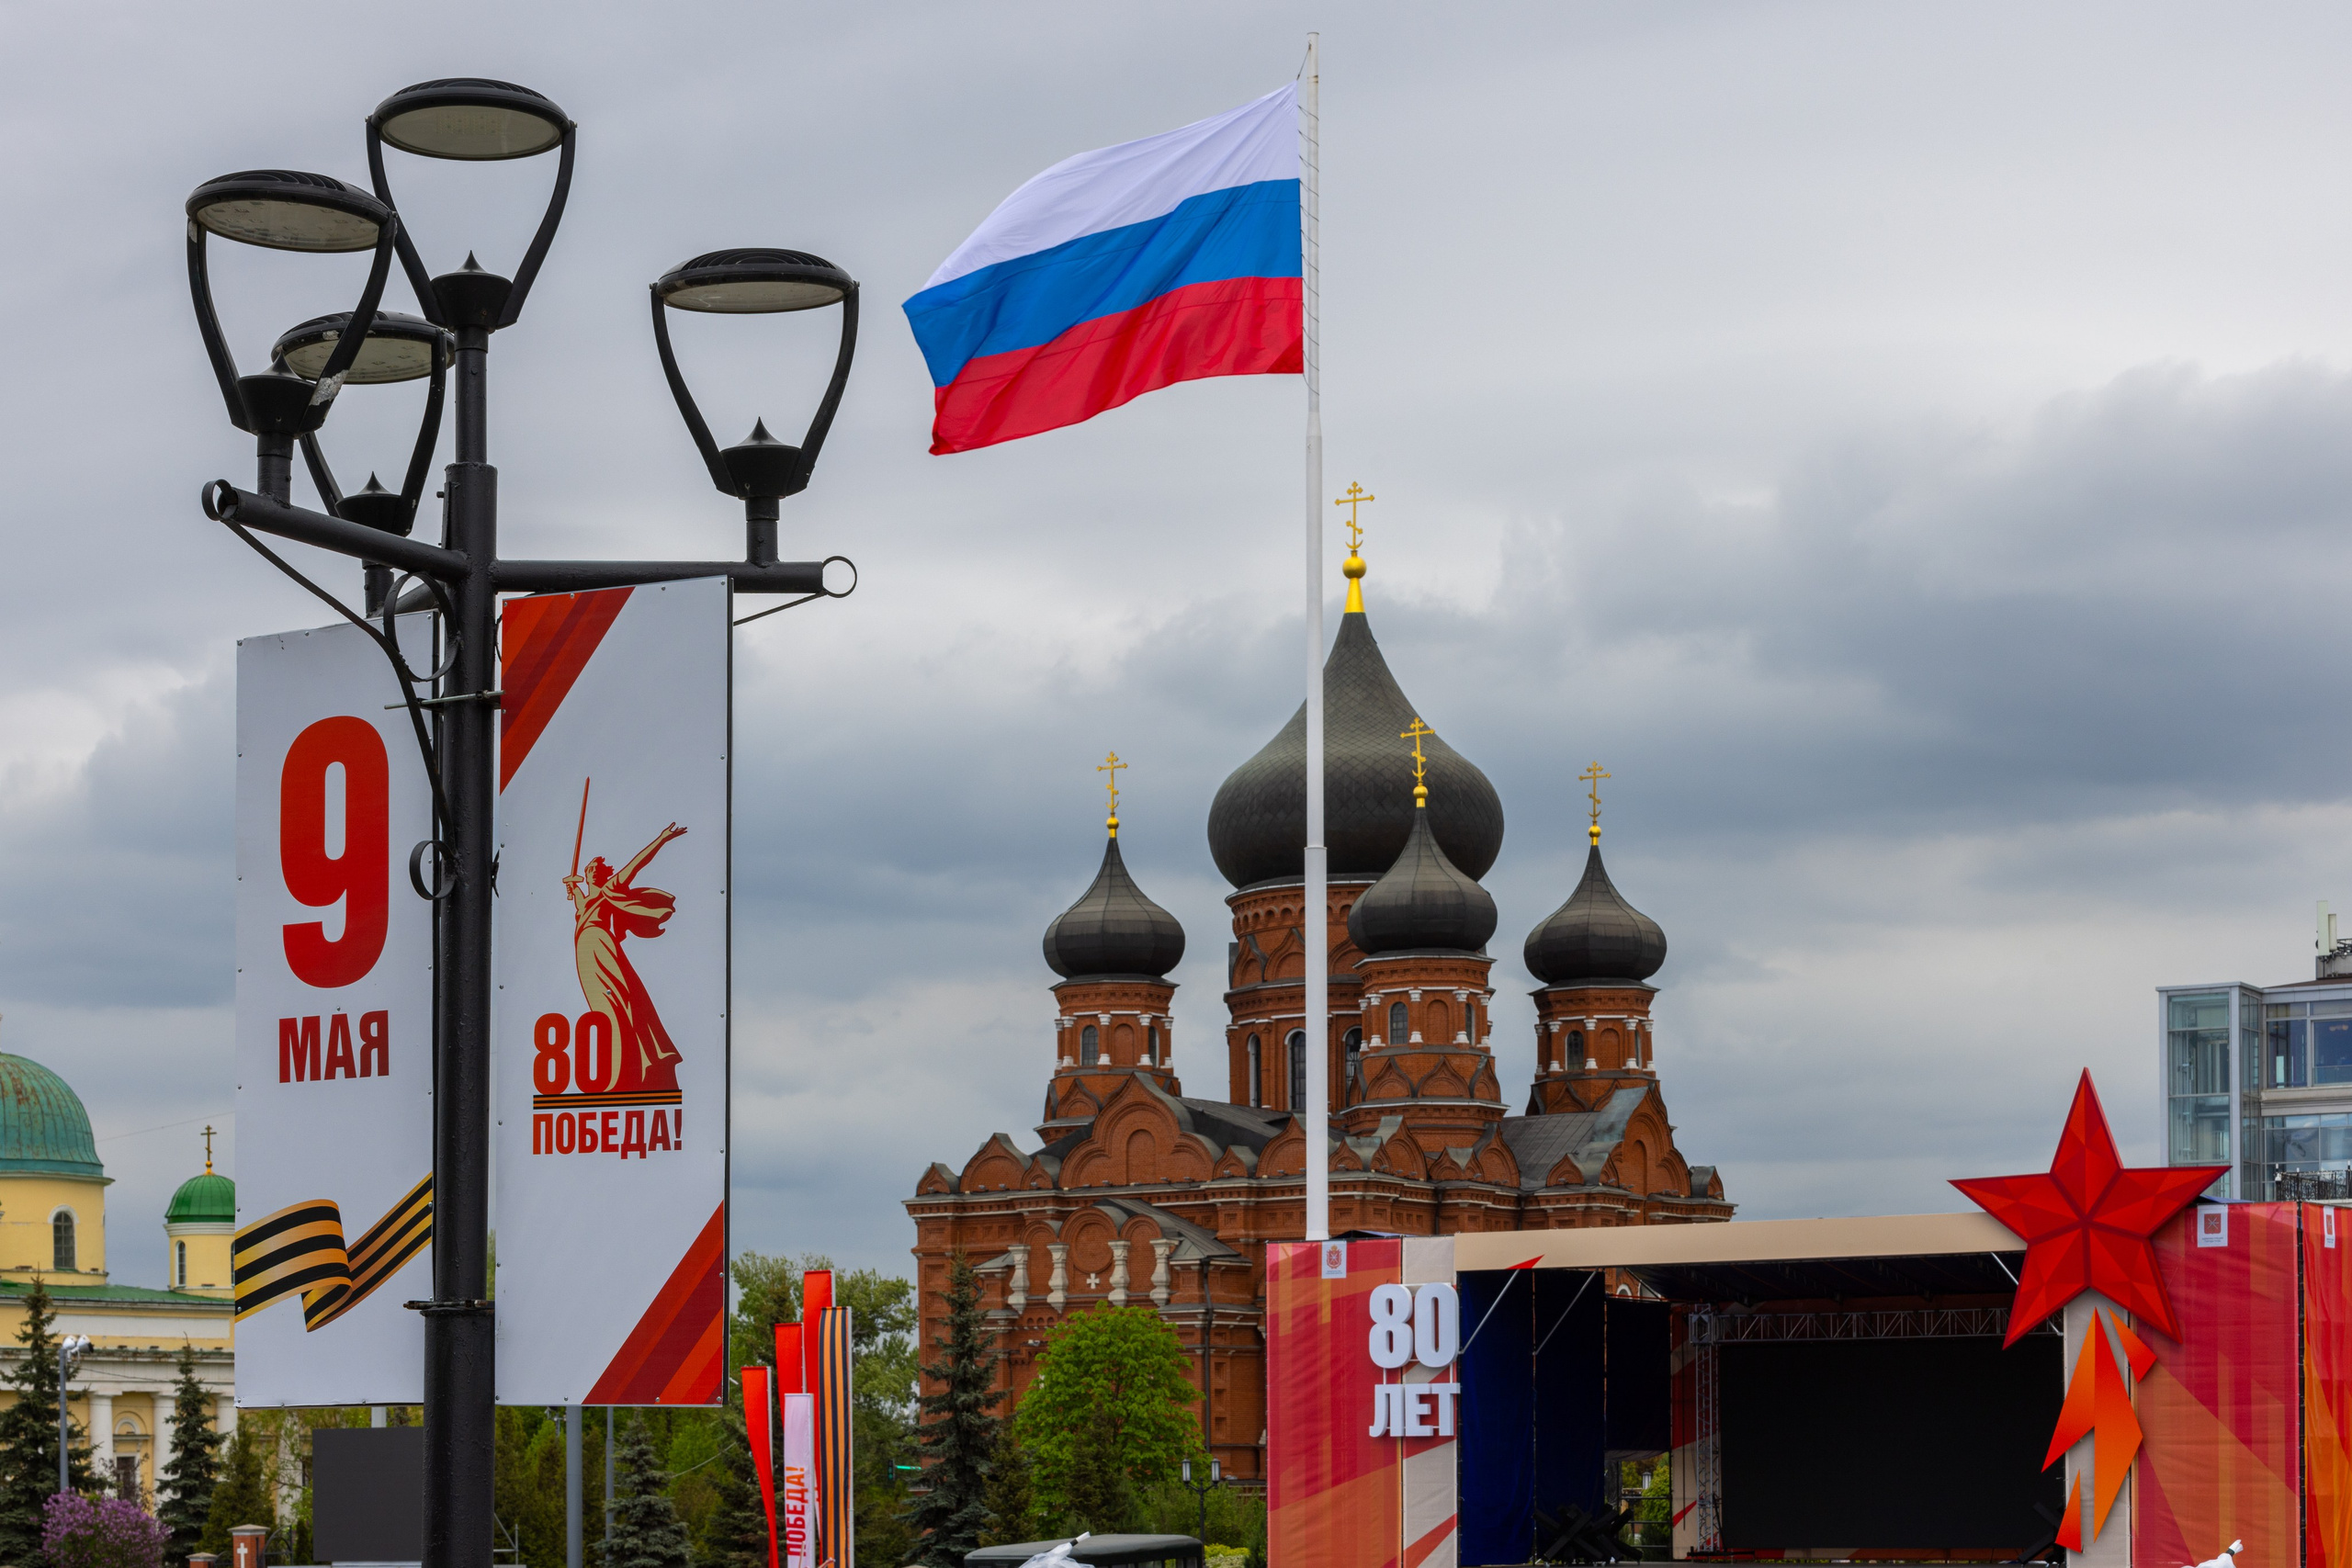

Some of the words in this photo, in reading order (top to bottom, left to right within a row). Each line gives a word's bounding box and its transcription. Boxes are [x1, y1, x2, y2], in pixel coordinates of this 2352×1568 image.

[280, 716, 389, 988] 9
[279, 1010, 390, 1083] МАЯ
[533, 1011, 613, 1095] 80
[533, 1109, 683, 1159] ПОБЕДА!
[1369, 1282, 1460, 1369] 80
[1369, 1382, 1461, 1438] ЛЕТ
[785, 1466, 808, 1557] ПОБЕДА!
